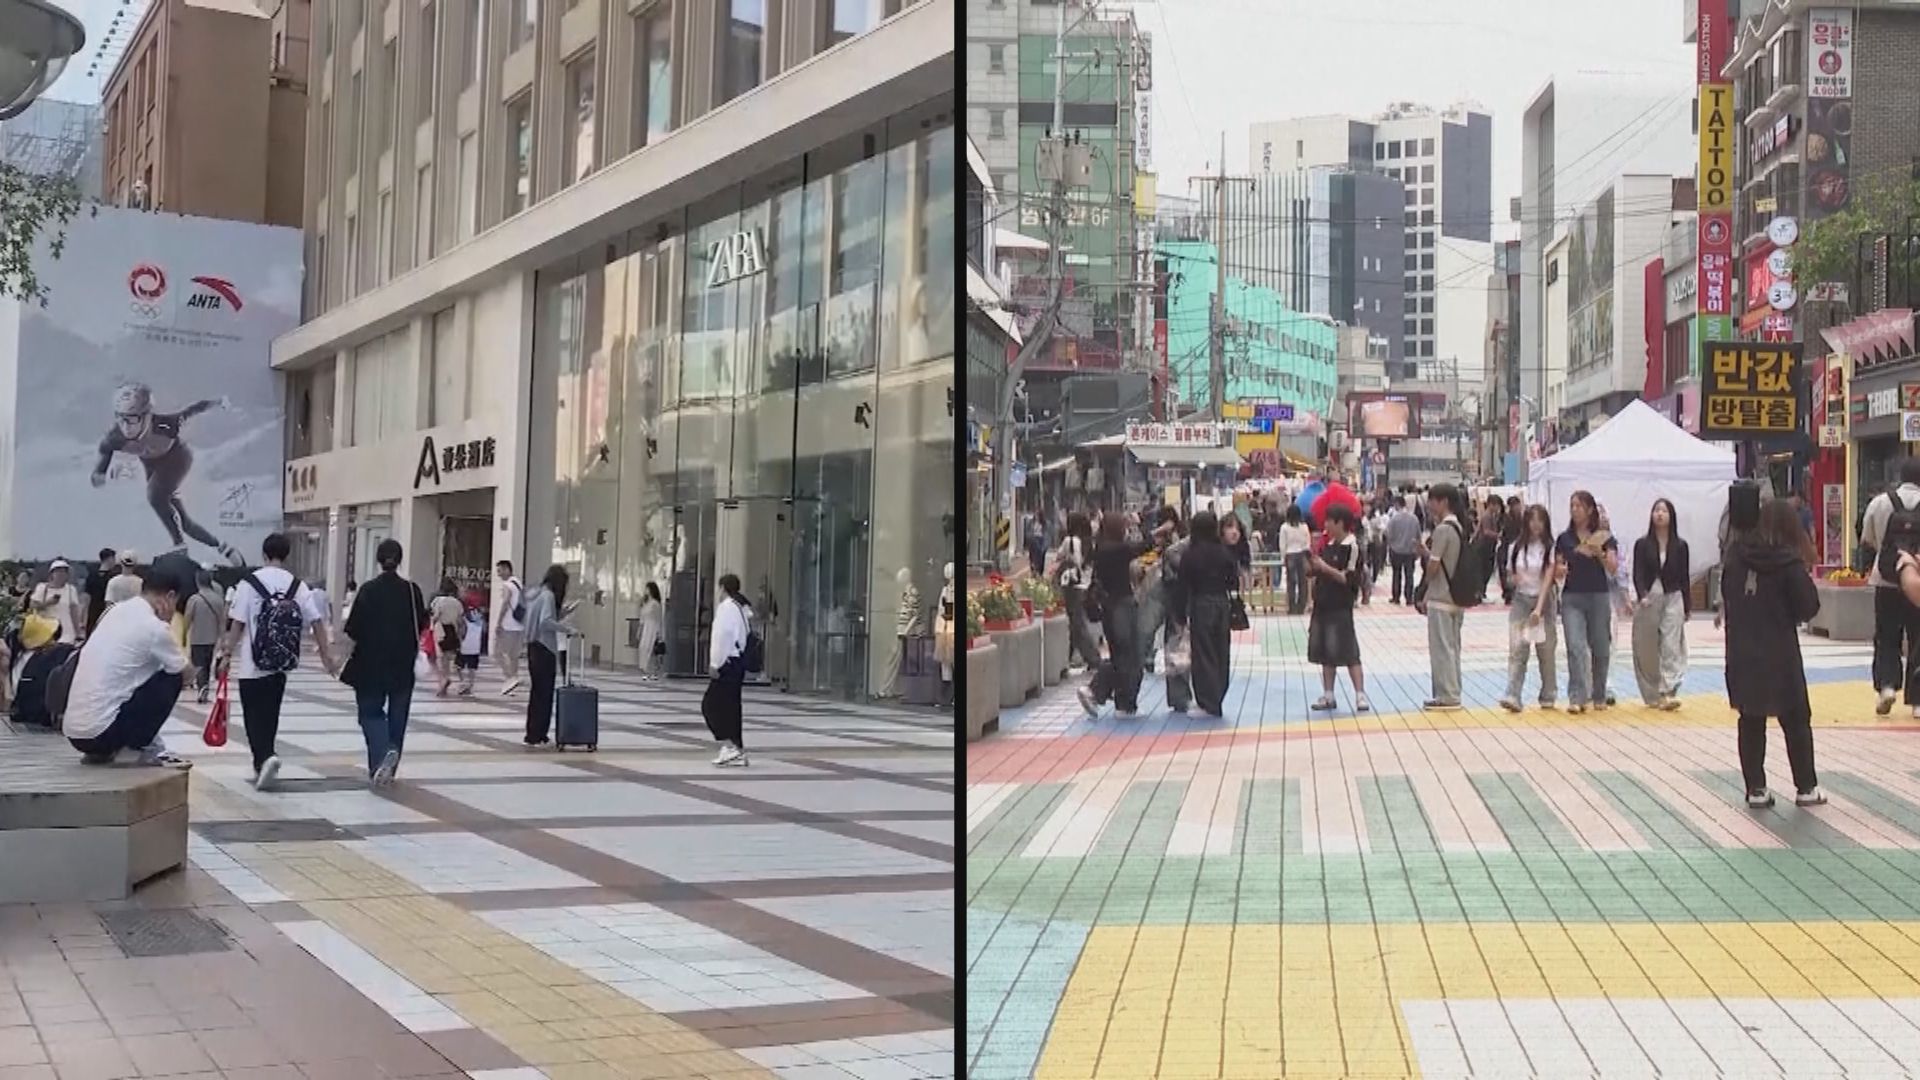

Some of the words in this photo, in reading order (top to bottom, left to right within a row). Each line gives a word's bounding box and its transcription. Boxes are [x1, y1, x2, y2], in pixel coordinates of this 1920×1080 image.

[1708, 89, 1725, 206] TATTOO
[1091, 206, 1111, 226] 6F
[704, 227, 768, 288] ZARA
[187, 293, 221, 309] ANTA
[1707, 271, 1723, 312] 떡볶이
[1714, 350, 1795, 392] 반값
[1712, 399, 1792, 428] 방탈출
[1132, 427, 1168, 440] 폰케이스
[442, 437, 496, 472] 亚朵酒店
